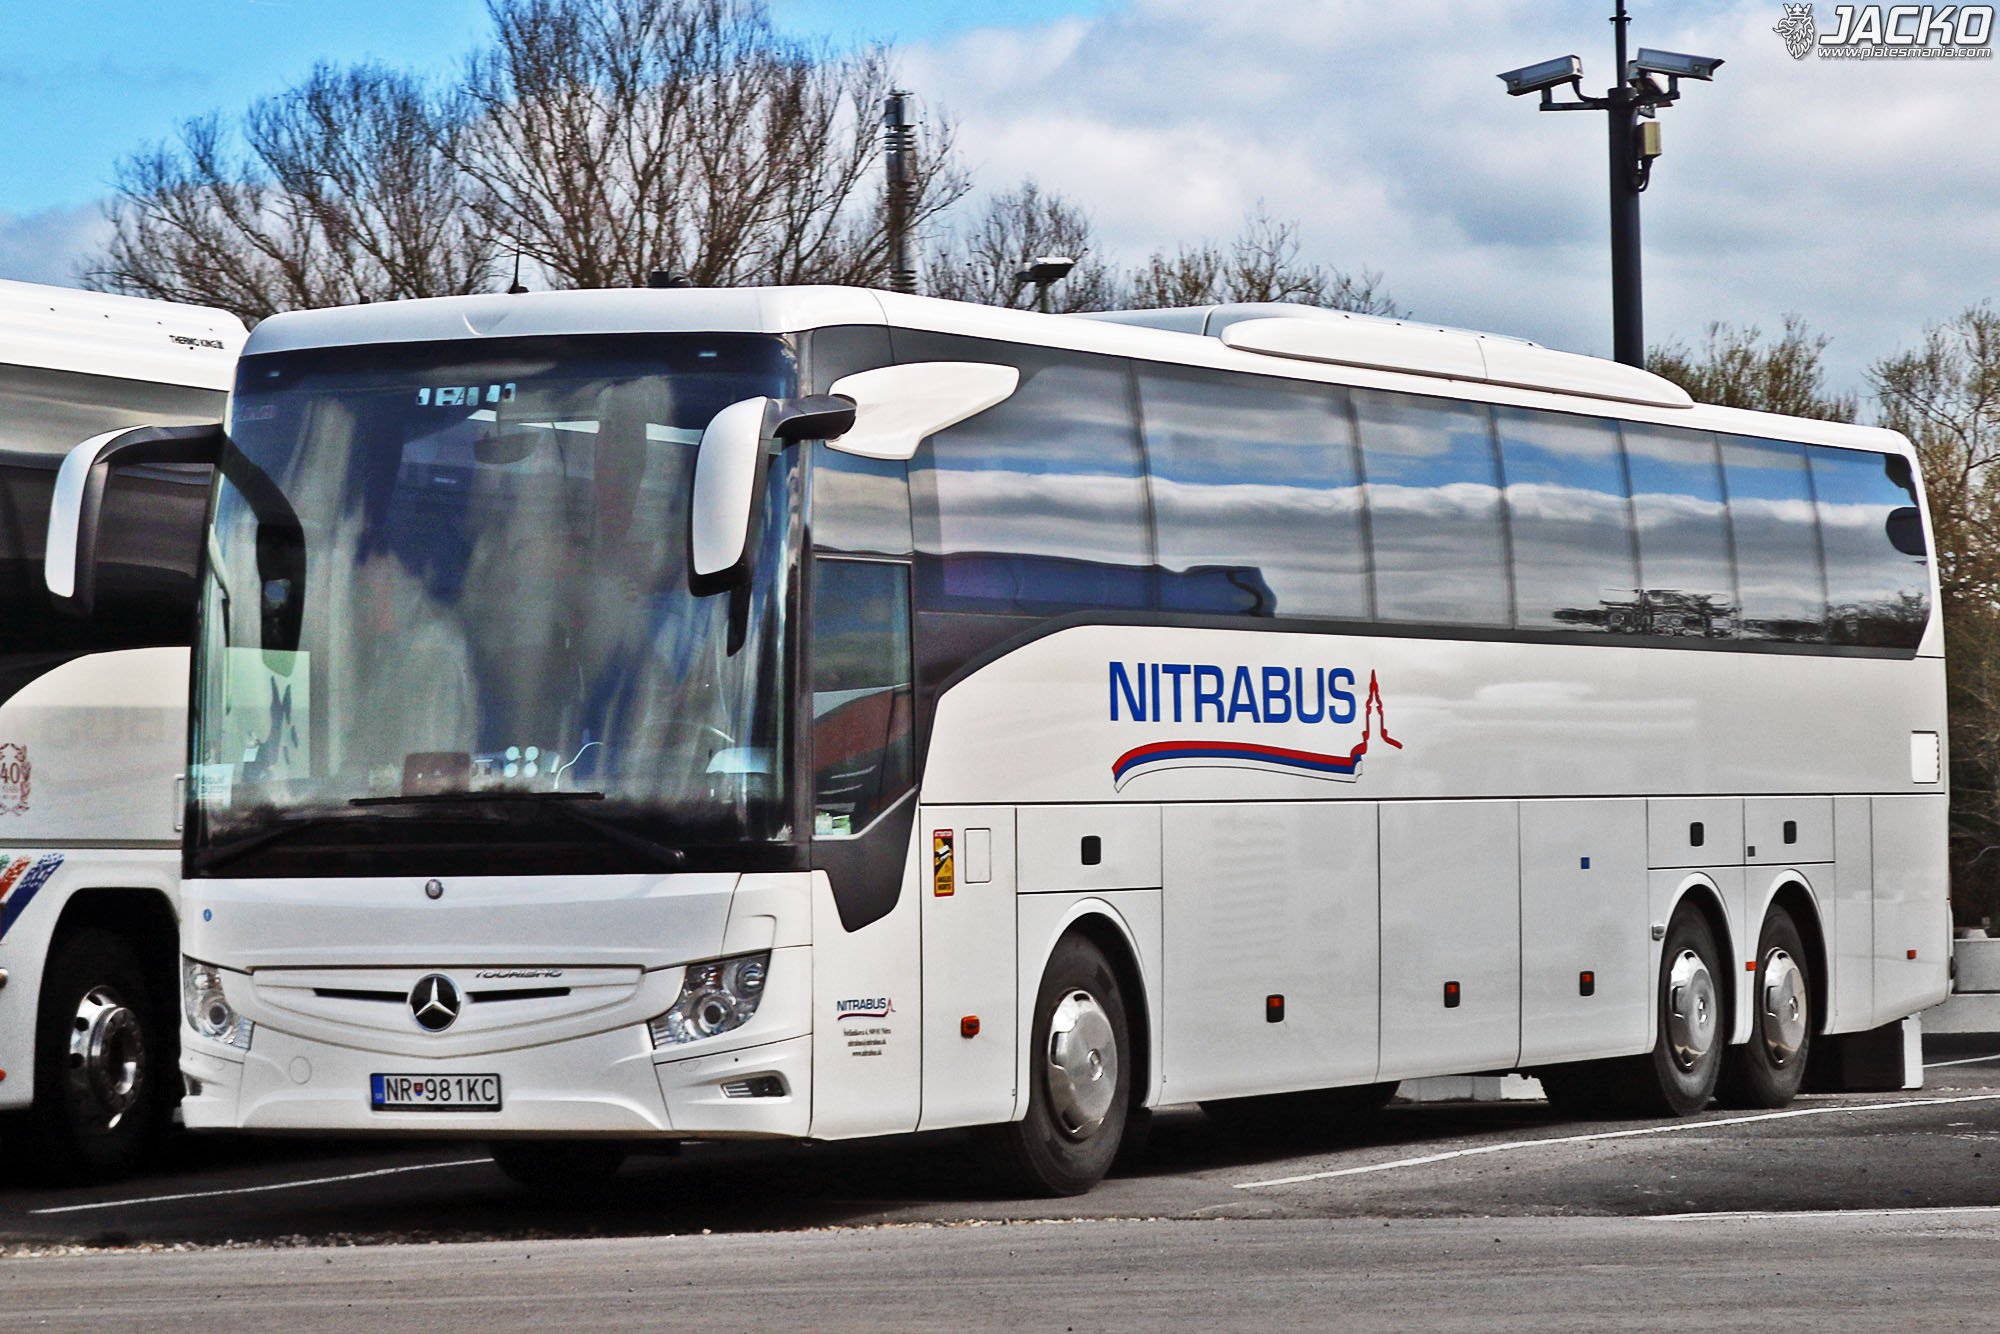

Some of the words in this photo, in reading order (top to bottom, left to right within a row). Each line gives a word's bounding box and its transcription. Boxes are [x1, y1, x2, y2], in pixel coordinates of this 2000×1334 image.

[1109, 661, 1357, 724] NITRABUS
[0, 762, 20, 784] 40
[475, 968, 562, 978] TOURISMO
[837, 998, 886, 1011] NITRABUS
